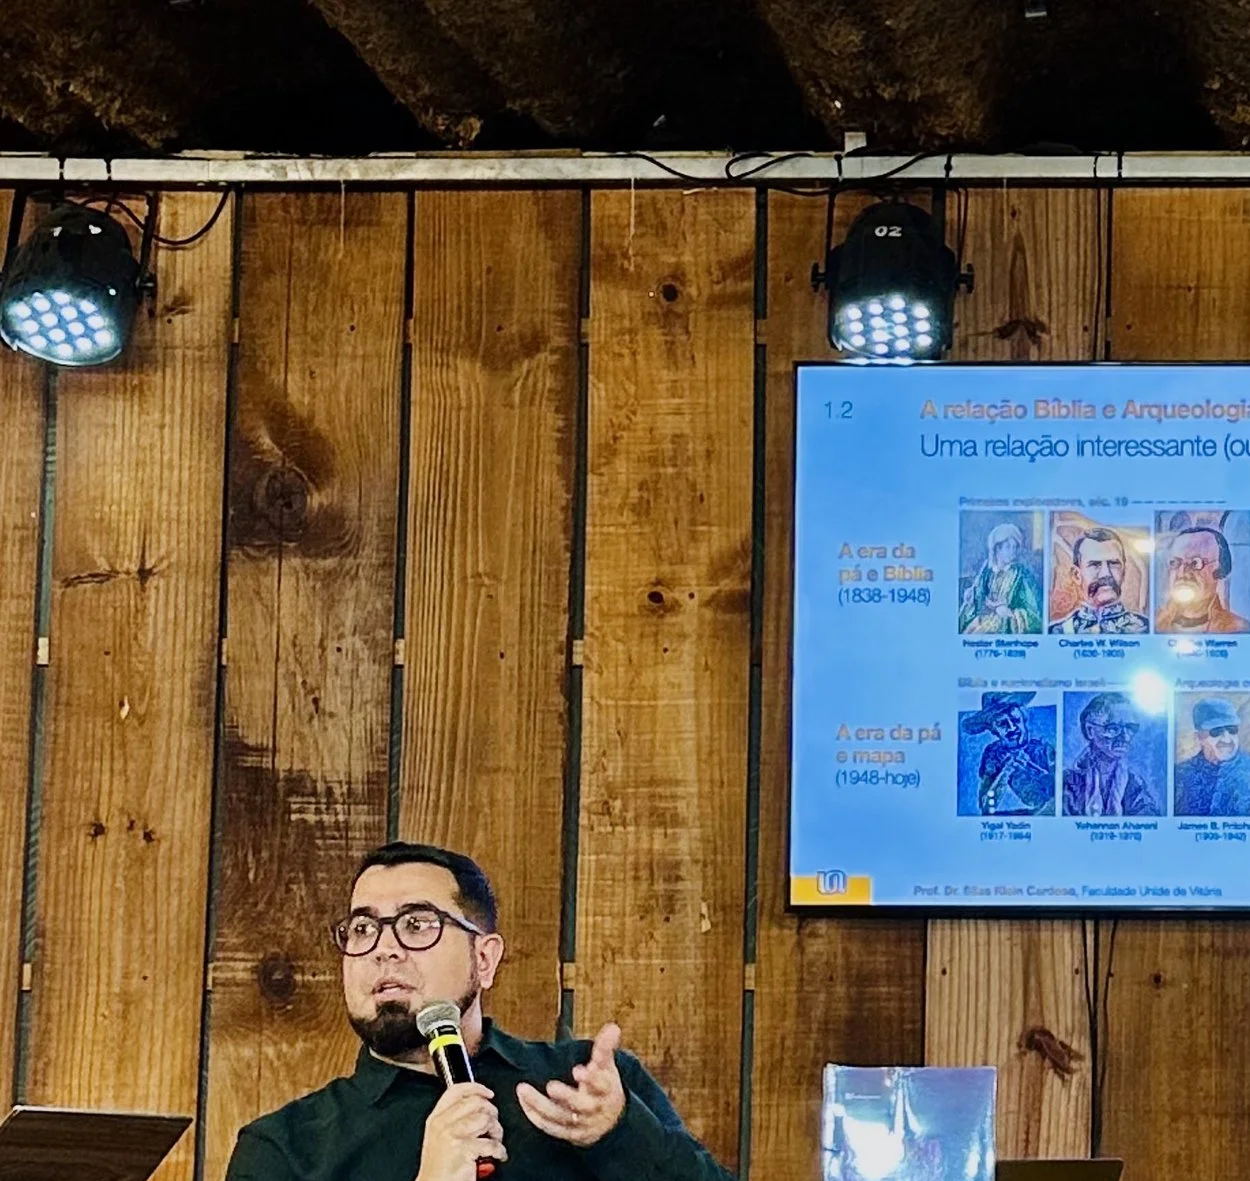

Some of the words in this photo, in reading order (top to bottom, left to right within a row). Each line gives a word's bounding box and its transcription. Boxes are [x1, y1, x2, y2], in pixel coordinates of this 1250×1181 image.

[874, 226, 902, 237] 02
[823, 401, 854, 420] 1.2
[919, 400, 938, 420] A
[943, 400, 1028, 424] relação
[1034, 398, 1097, 420] Bíblia
[1102, 403, 1118, 420] e
[920, 434, 979, 458] Uma
[985, 434, 1070, 463] relação
[1075, 434, 1217, 458] interessante
[838, 543, 855, 560] A
[858, 546, 888, 560] era
[892, 543, 916, 560] da
[838, 566, 863, 586] pá
[867, 570, 878, 583] e
[883, 565, 934, 584] Bíblia
[837, 587, 932, 607] (1838-1948)
[835, 724, 852, 741] A
[855, 727, 886, 742] era
[890, 724, 914, 742] da
[918, 723, 942, 747] pá
[836, 750, 848, 764] e
[853, 750, 906, 769] mapa
[835, 769, 921, 788] (1948-hoje)
[913, 885, 940, 897] Prof.
[944, 885, 960, 897] Dr.
